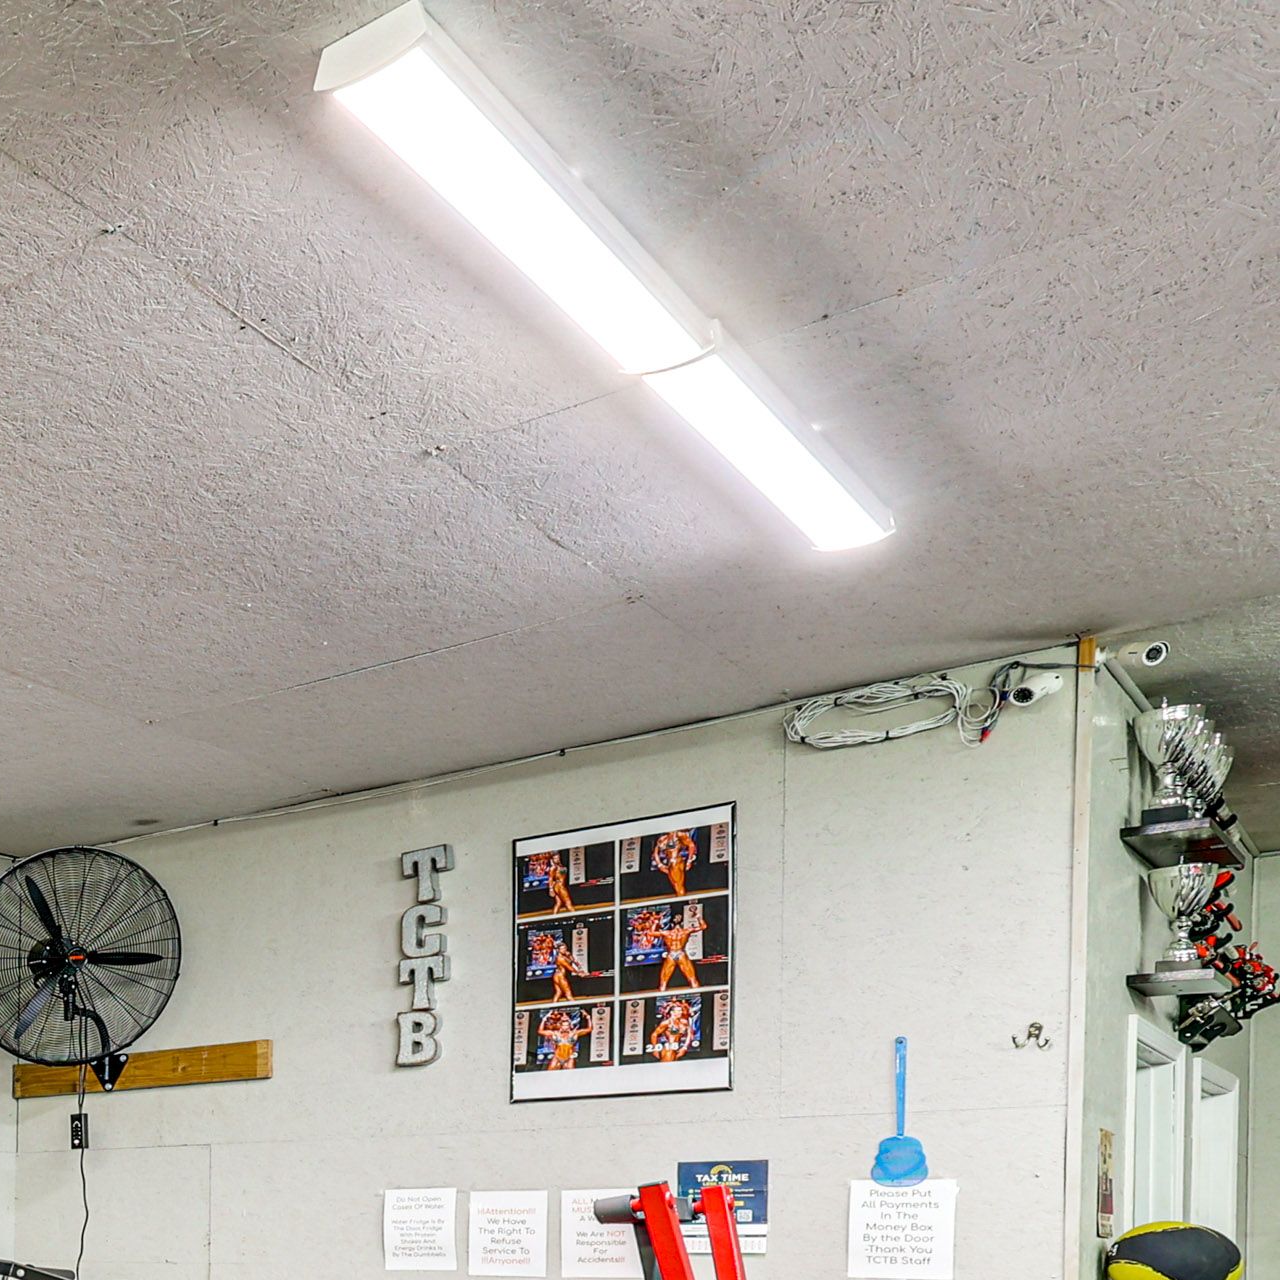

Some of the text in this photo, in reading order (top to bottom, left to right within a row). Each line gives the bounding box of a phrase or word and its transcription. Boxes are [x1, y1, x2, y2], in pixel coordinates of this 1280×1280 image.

[396, 844, 454, 1067] TCTB
[696, 1173, 749, 1182] TAX TIME
[870, 1189, 932, 1197] Please Put
[880, 1200, 939, 1209] Payments
[880, 1211, 918, 1220] In The
[486, 1218, 527, 1226] We Have
[478, 1227, 536, 1236] The Right To
[866, 1223, 933, 1232] Money Box
[490, 1237, 522, 1245] Refuse
[576, 1239, 626, 1247] Responsible
[863, 1234, 934, 1243] By the Door
[482, 1246, 530, 1255] Service To
[865, 1245, 933, 1254] -Thank You
[866, 1255, 931, 1265] TCTB Staff
